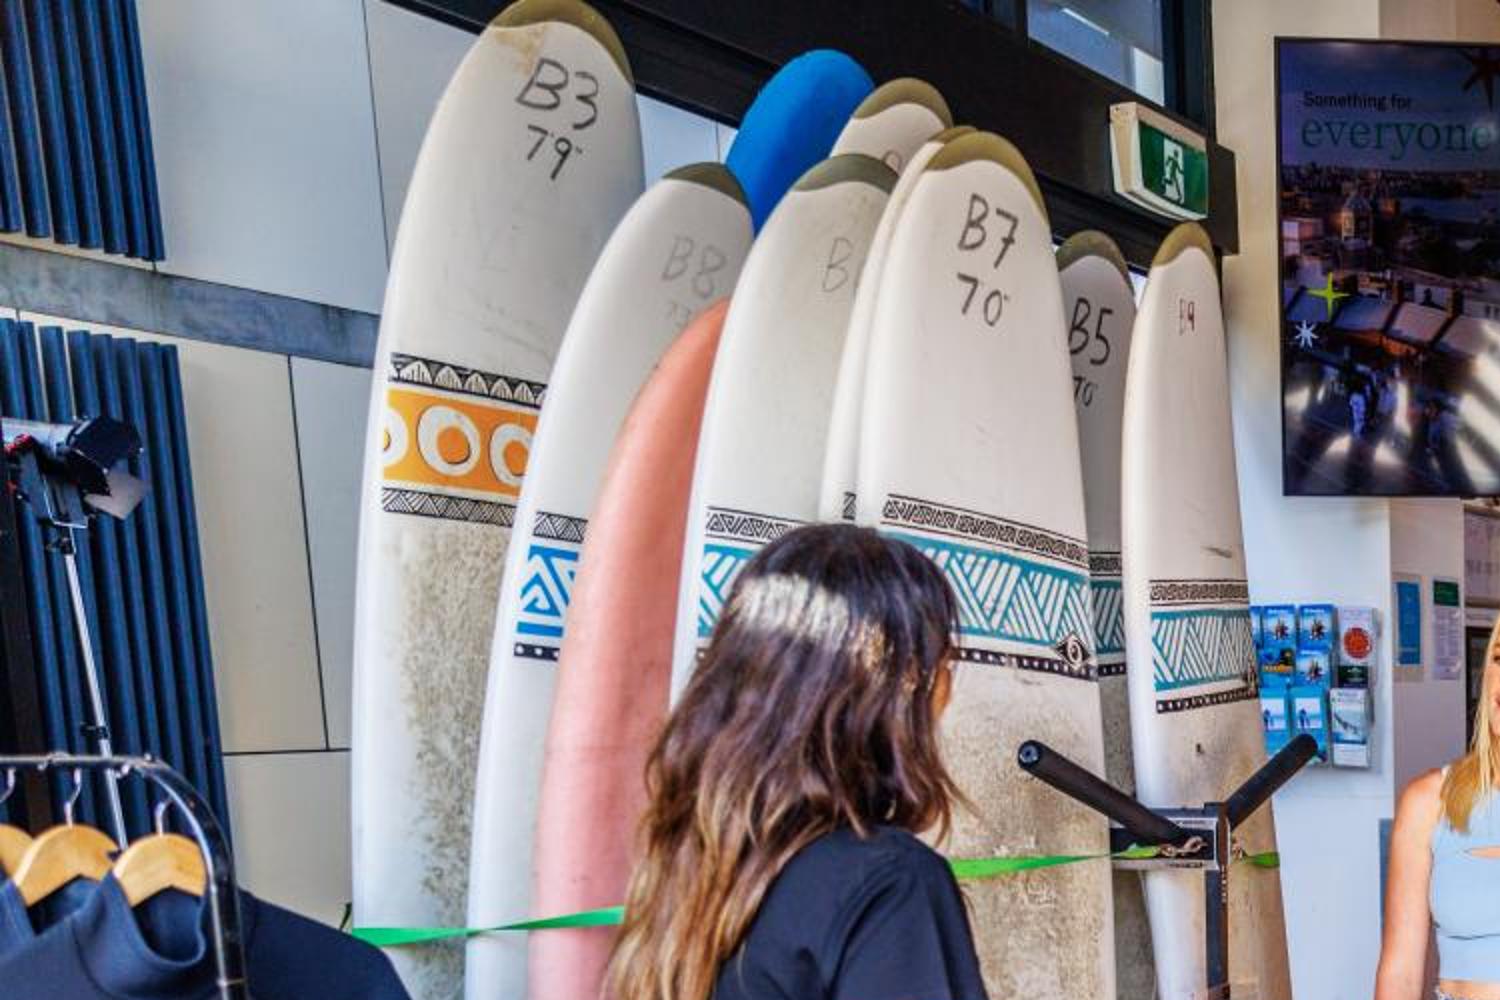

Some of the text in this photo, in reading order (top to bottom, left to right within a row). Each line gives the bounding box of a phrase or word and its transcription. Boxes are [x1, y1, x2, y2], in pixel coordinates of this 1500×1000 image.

[514, 57, 600, 130] B3
[1302, 91, 1412, 112] Something for
[1301, 117, 1490, 160] everyone
[957, 192, 1019, 270] B7
[1067, 297, 1113, 366] B5
